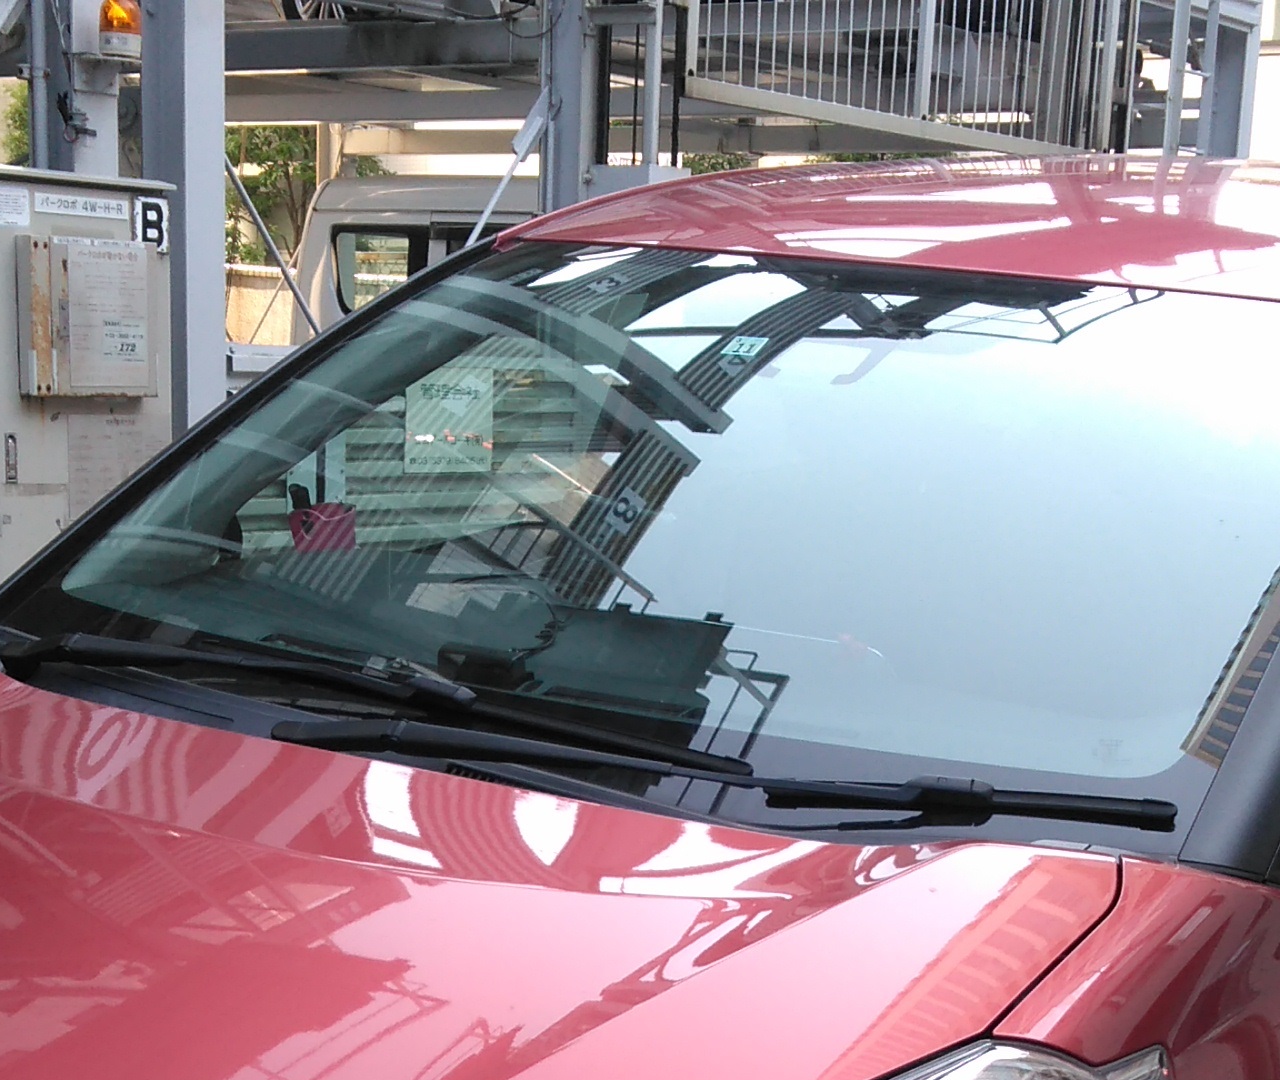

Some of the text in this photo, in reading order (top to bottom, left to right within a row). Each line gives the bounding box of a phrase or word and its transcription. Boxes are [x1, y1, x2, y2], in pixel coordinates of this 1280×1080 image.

[40, 196, 78, 210] パークロボ
[81, 200, 123, 215] 4W-H-R
[141, 201, 164, 248] B
